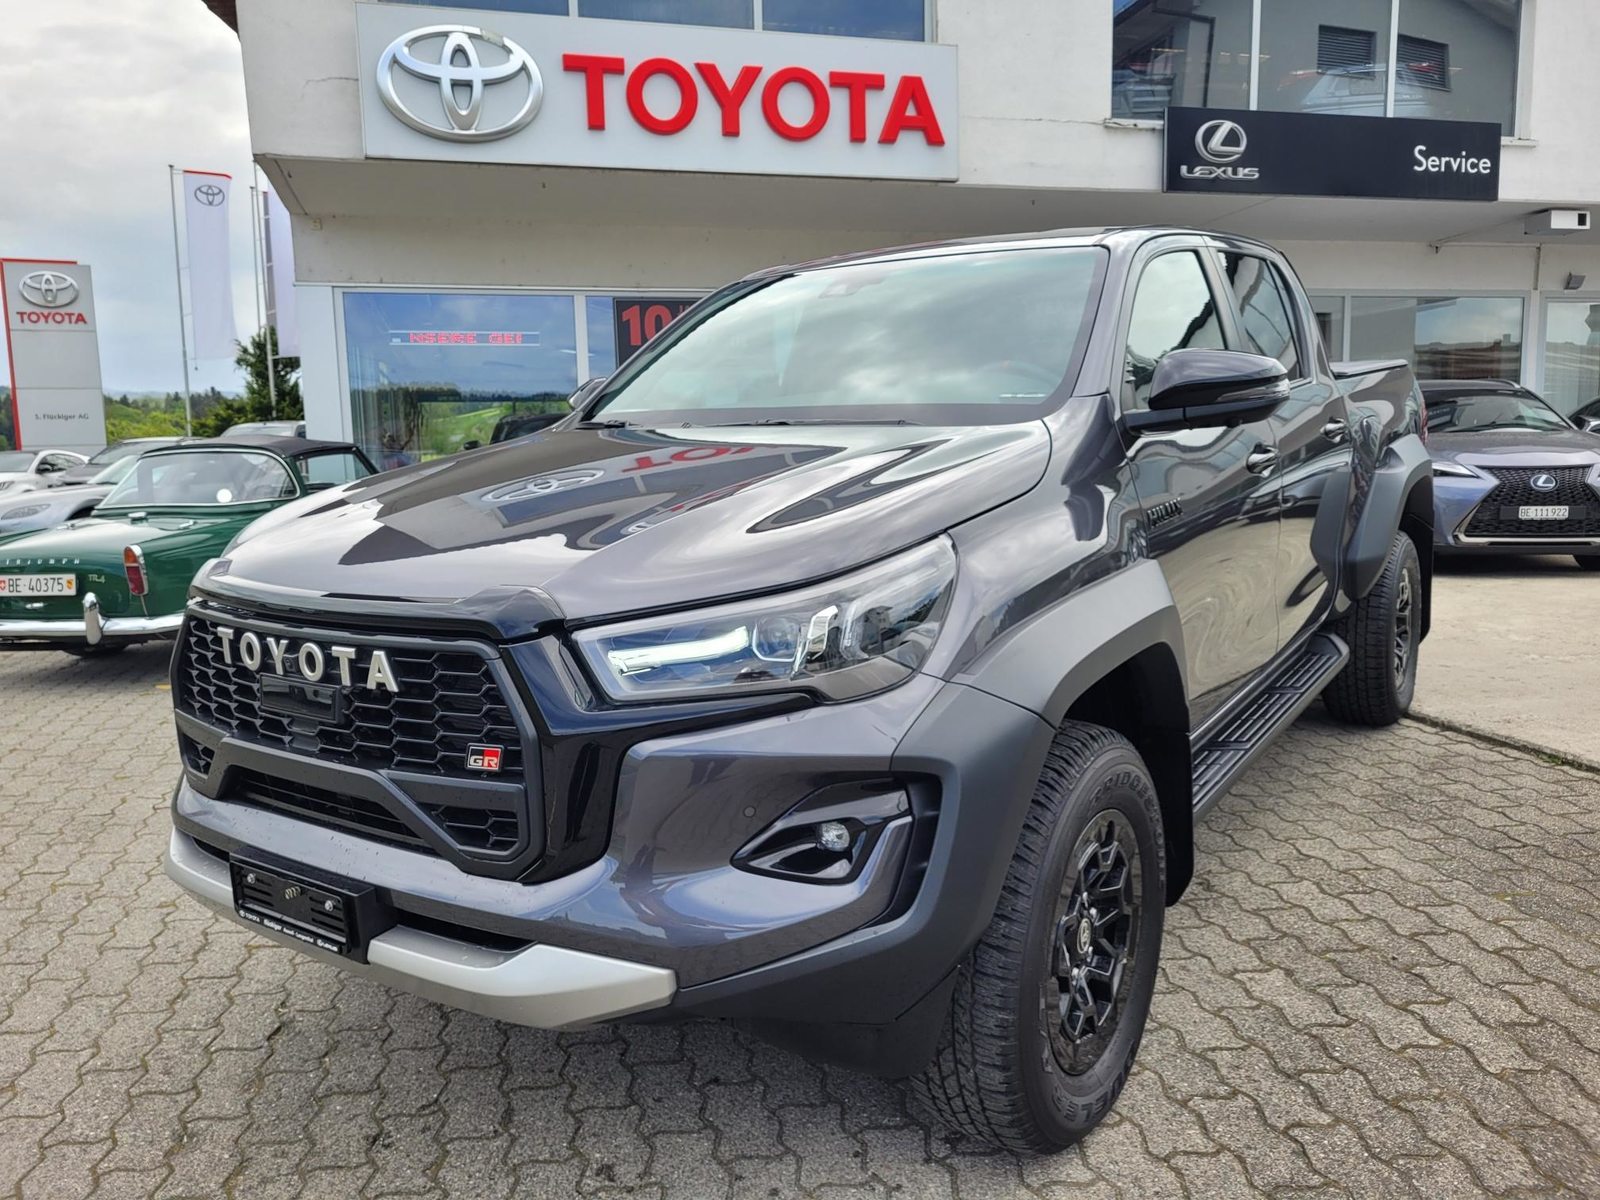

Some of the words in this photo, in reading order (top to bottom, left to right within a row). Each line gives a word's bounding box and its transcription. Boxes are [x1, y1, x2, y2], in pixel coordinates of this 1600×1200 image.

[562, 53, 945, 146] TOYOTA
[1413, 145, 1491, 173] Service
[1180, 165, 1260, 180] LEXUS
[16, 311, 88, 324] TOYOTA
[78, 412, 89, 420] AG
[217, 626, 399, 692] TOYOTA
[470, 755, 498, 768] GR
